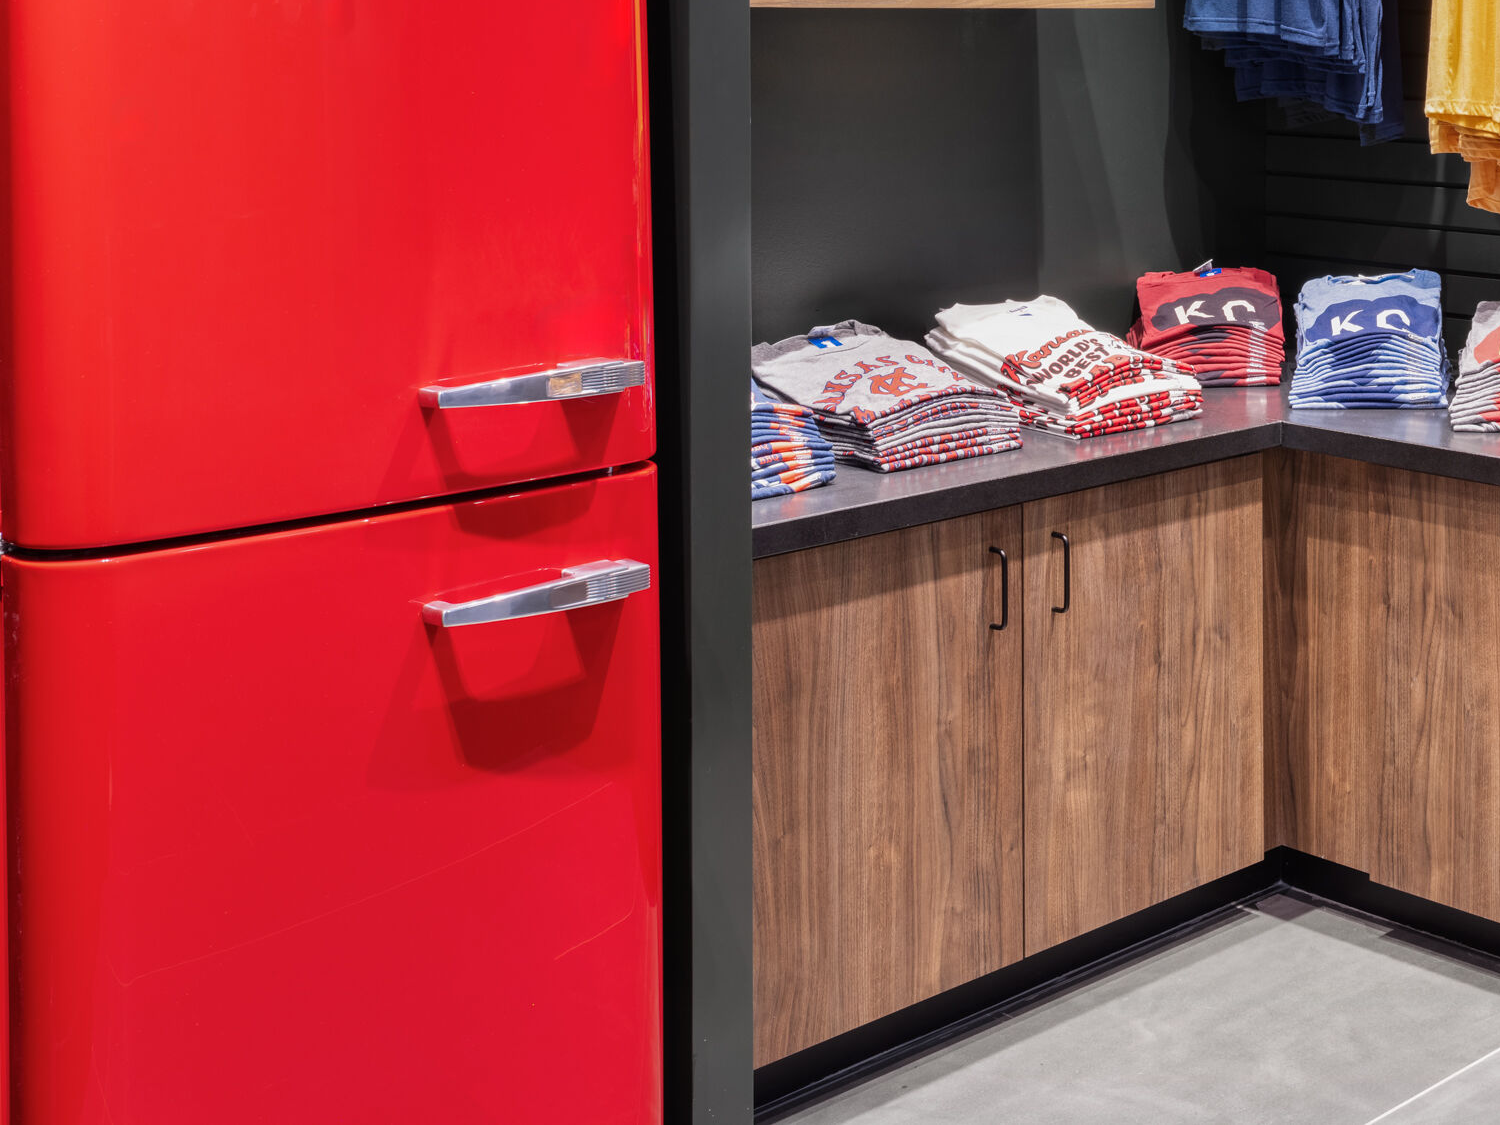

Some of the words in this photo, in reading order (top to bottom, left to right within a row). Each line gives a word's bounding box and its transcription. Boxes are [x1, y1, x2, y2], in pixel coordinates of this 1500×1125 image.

[1174, 299, 1256, 325] KC
[1331, 309, 1411, 336] KC
[1027, 338, 1105, 386] WORLD'S
[1064, 344, 1110, 378] BEST
